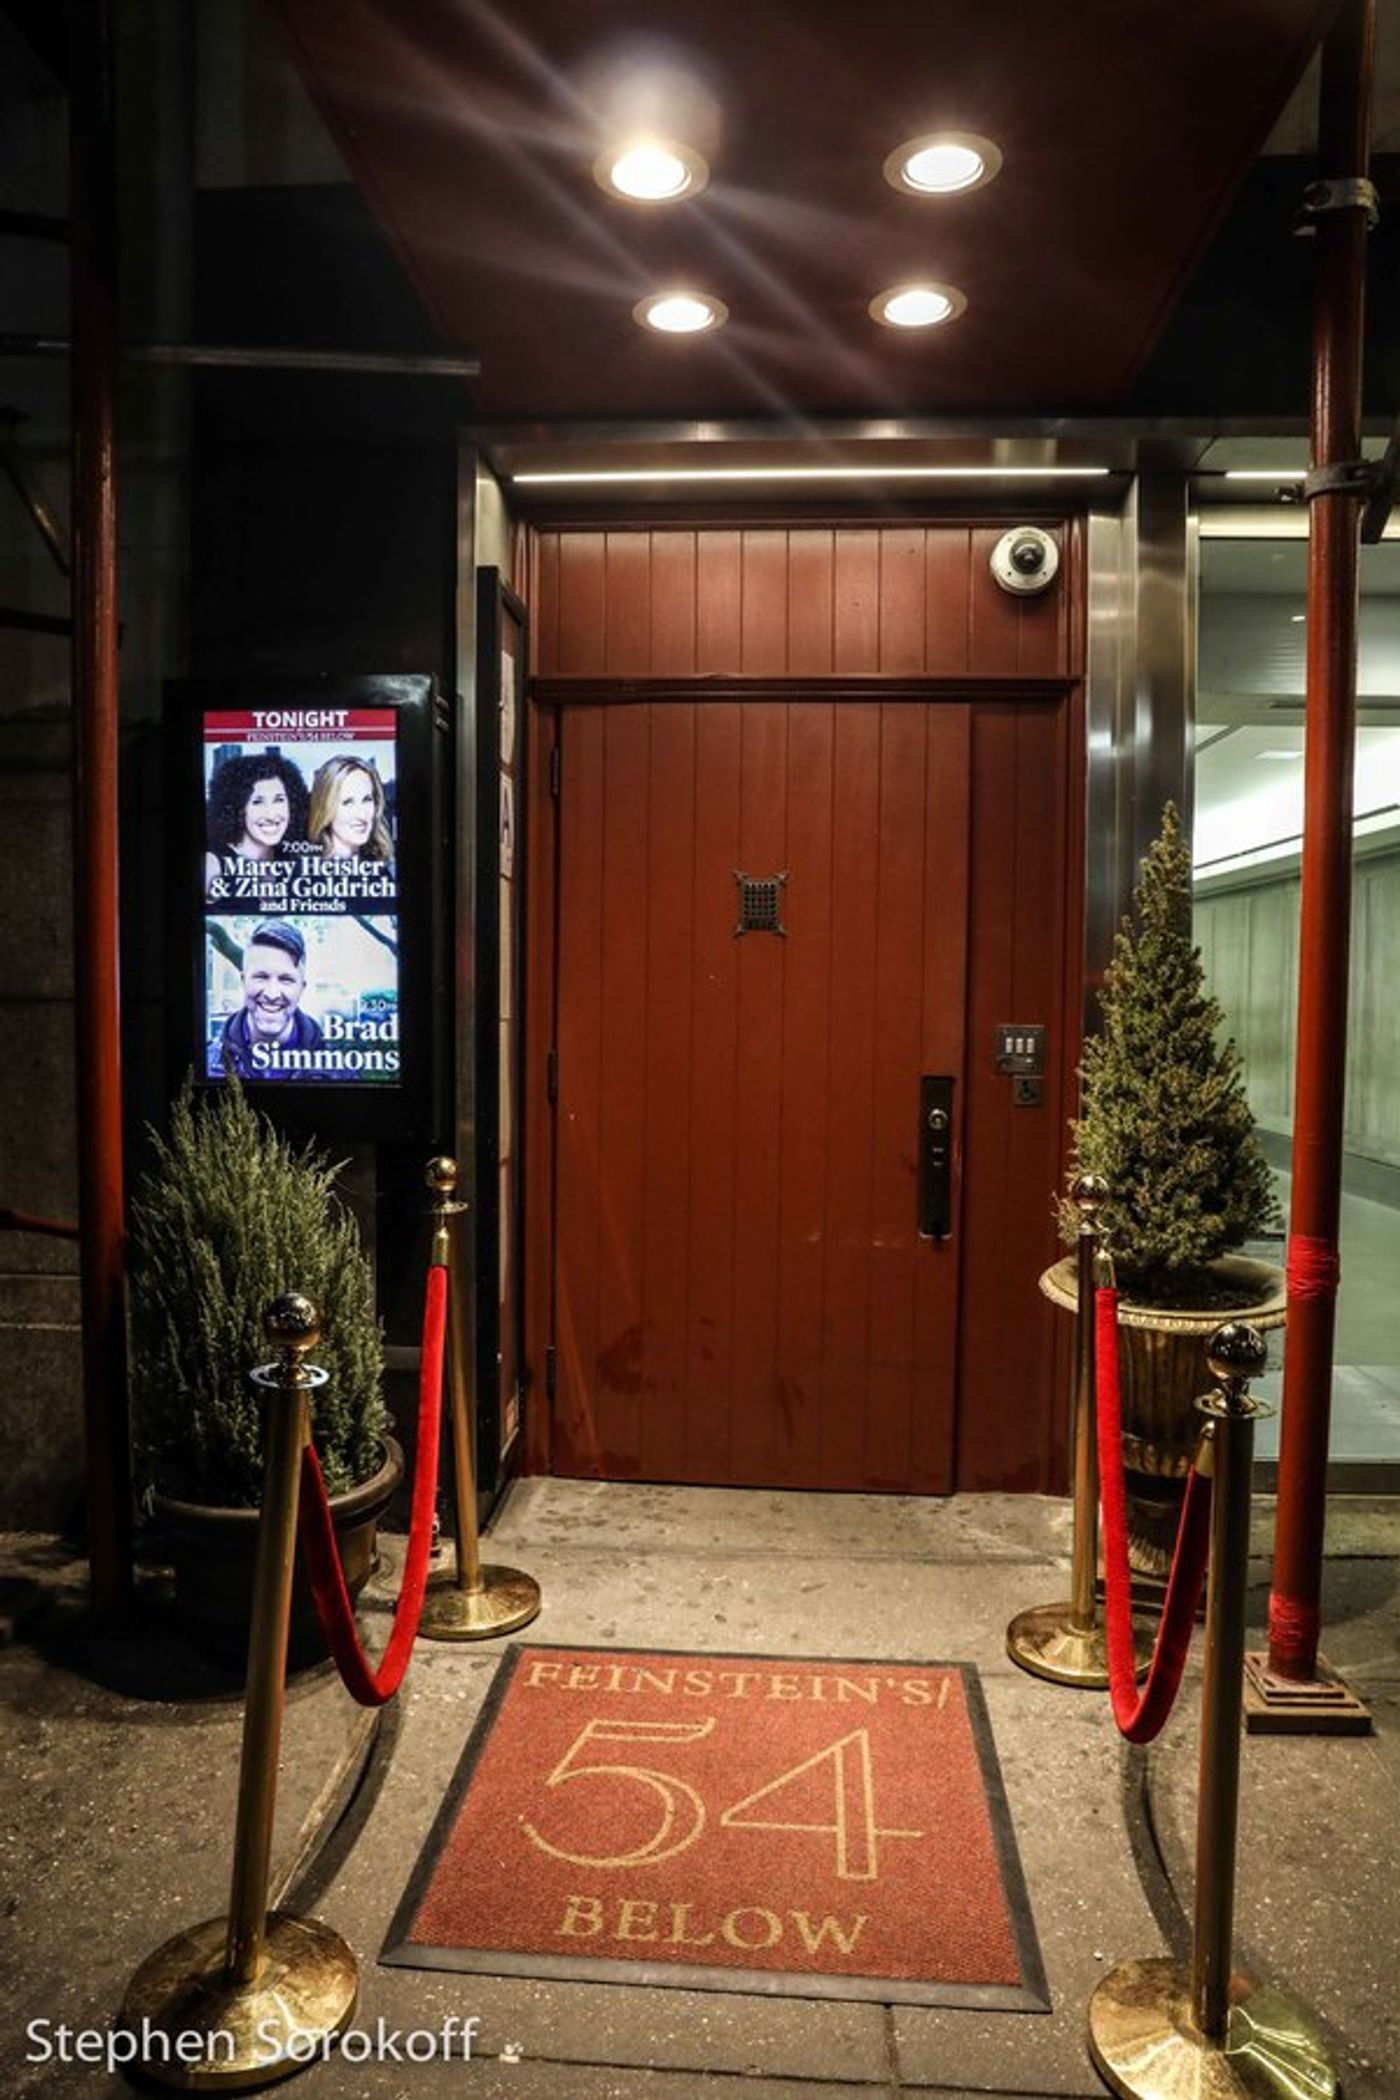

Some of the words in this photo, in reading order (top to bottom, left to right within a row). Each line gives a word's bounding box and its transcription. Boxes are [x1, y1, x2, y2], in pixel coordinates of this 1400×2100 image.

[252, 711, 349, 727] TONIGHT
[223, 857, 295, 882] Marcy
[301, 857, 384, 877] Heisler
[210, 878, 231, 898] &
[235, 878, 288, 898] Zina
[292, 877, 396, 898] Goldrich
[259, 900, 287, 912] and
[290, 899, 346, 912] Friends
[323, 1014, 399, 1041] Brad
[251, 1042, 400, 1070] Simmons
[517, 1717, 925, 1880] 54
[556, 1897, 869, 1955] BELOW
